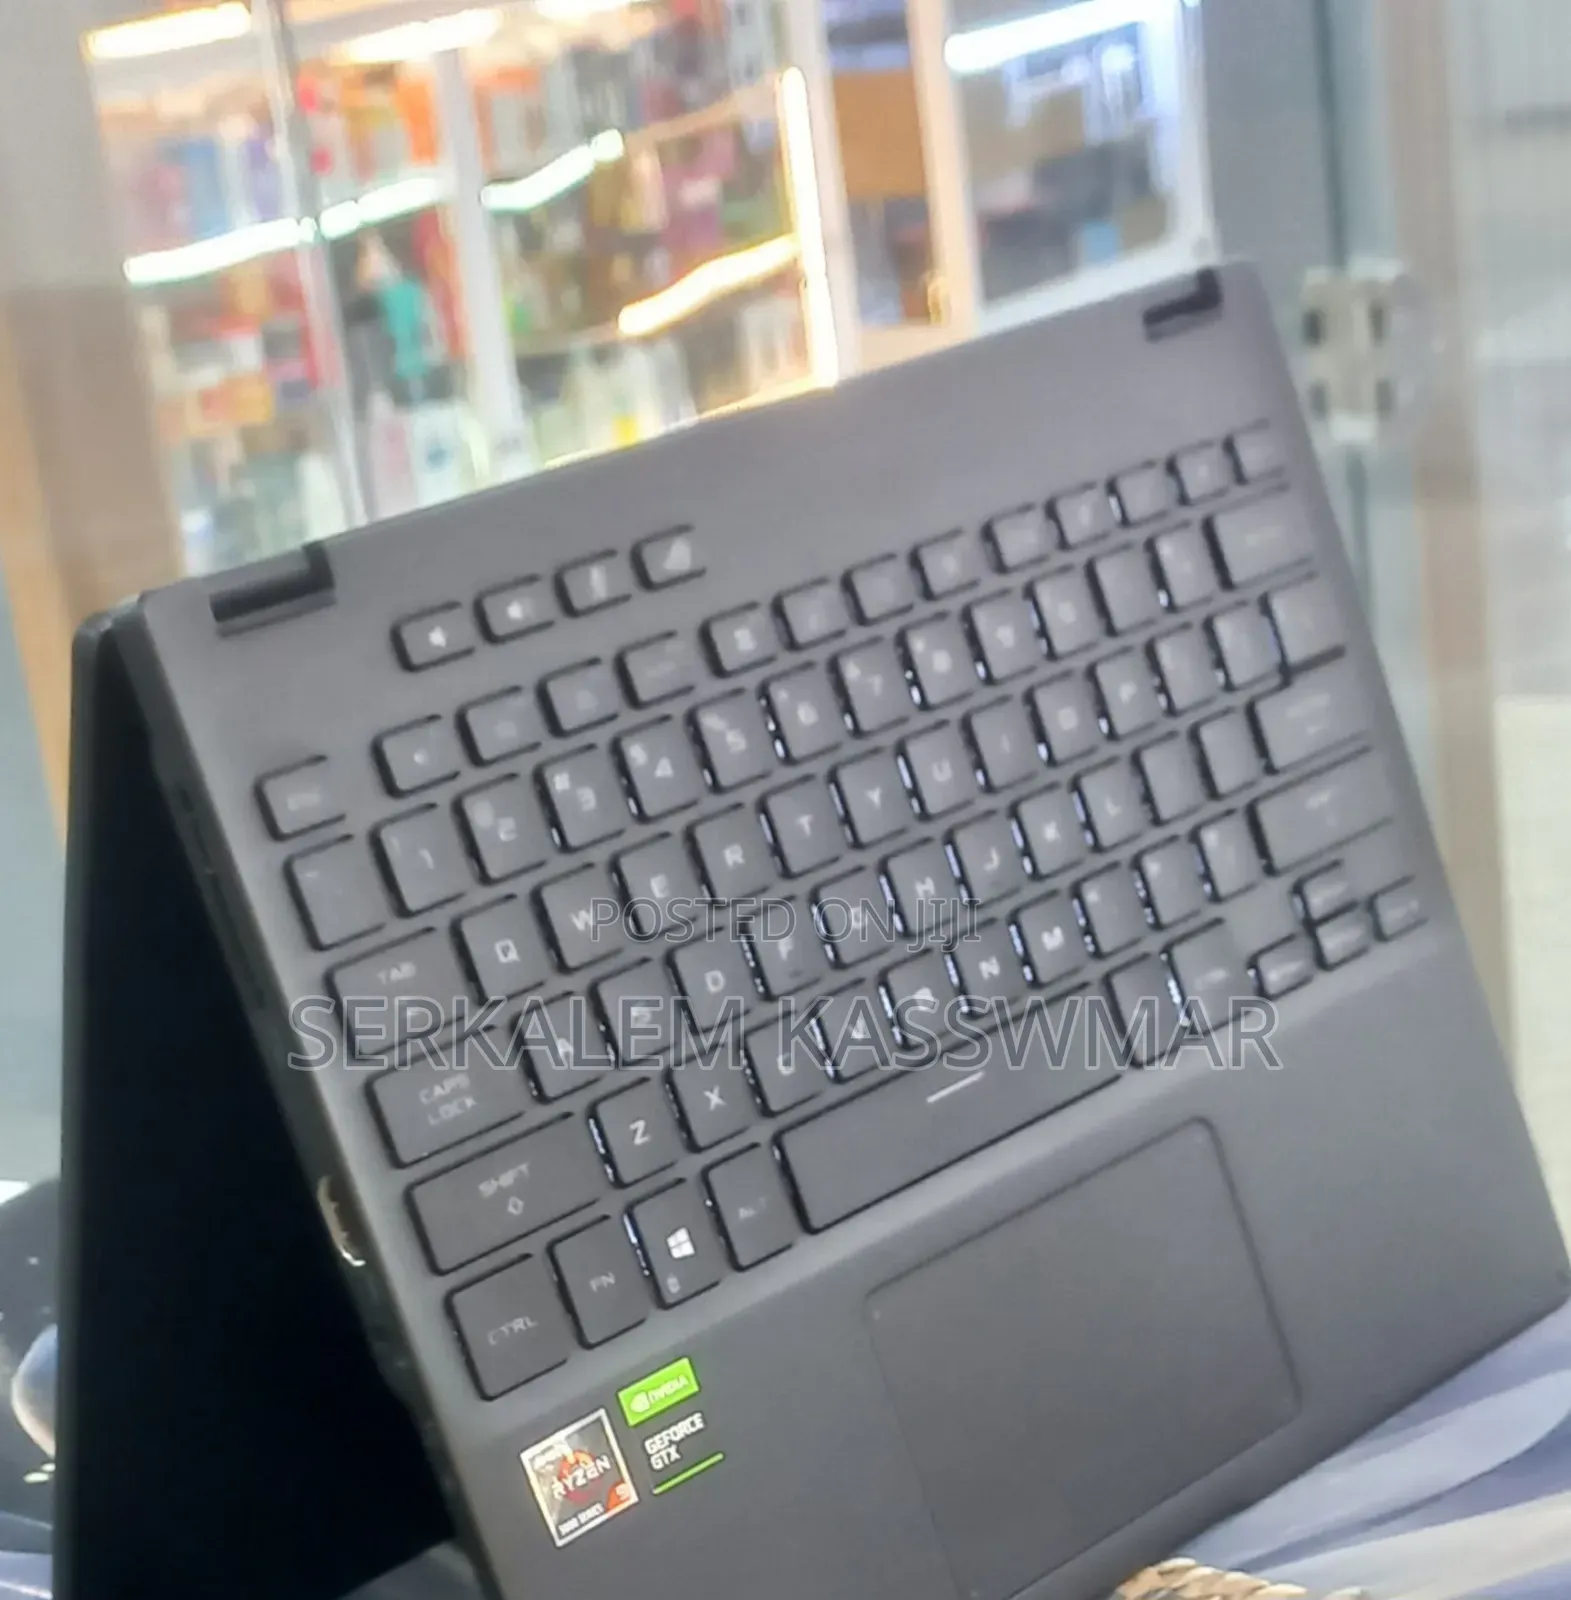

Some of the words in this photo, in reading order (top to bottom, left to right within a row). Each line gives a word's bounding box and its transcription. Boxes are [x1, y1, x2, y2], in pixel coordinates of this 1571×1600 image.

[864, 784, 884, 810] Y
[797, 813, 815, 838] T
[722, 842, 746, 870] R
[650, 873, 670, 900] E
[913, 875, 937, 898] H
[494, 937, 521, 965] Q
[977, 954, 1001, 981] N
[704, 969, 727, 994] D
[703, 1085, 727, 1111] X
[629, 1118, 651, 1146] Z
[587, 1270, 617, 1294] FN
[487, 1314, 540, 1347] CTRL
[644, 1411, 706, 1457] GEFORCE
[650, 1443, 683, 1472] GTX
[550, 1453, 613, 1502] RYZEN
